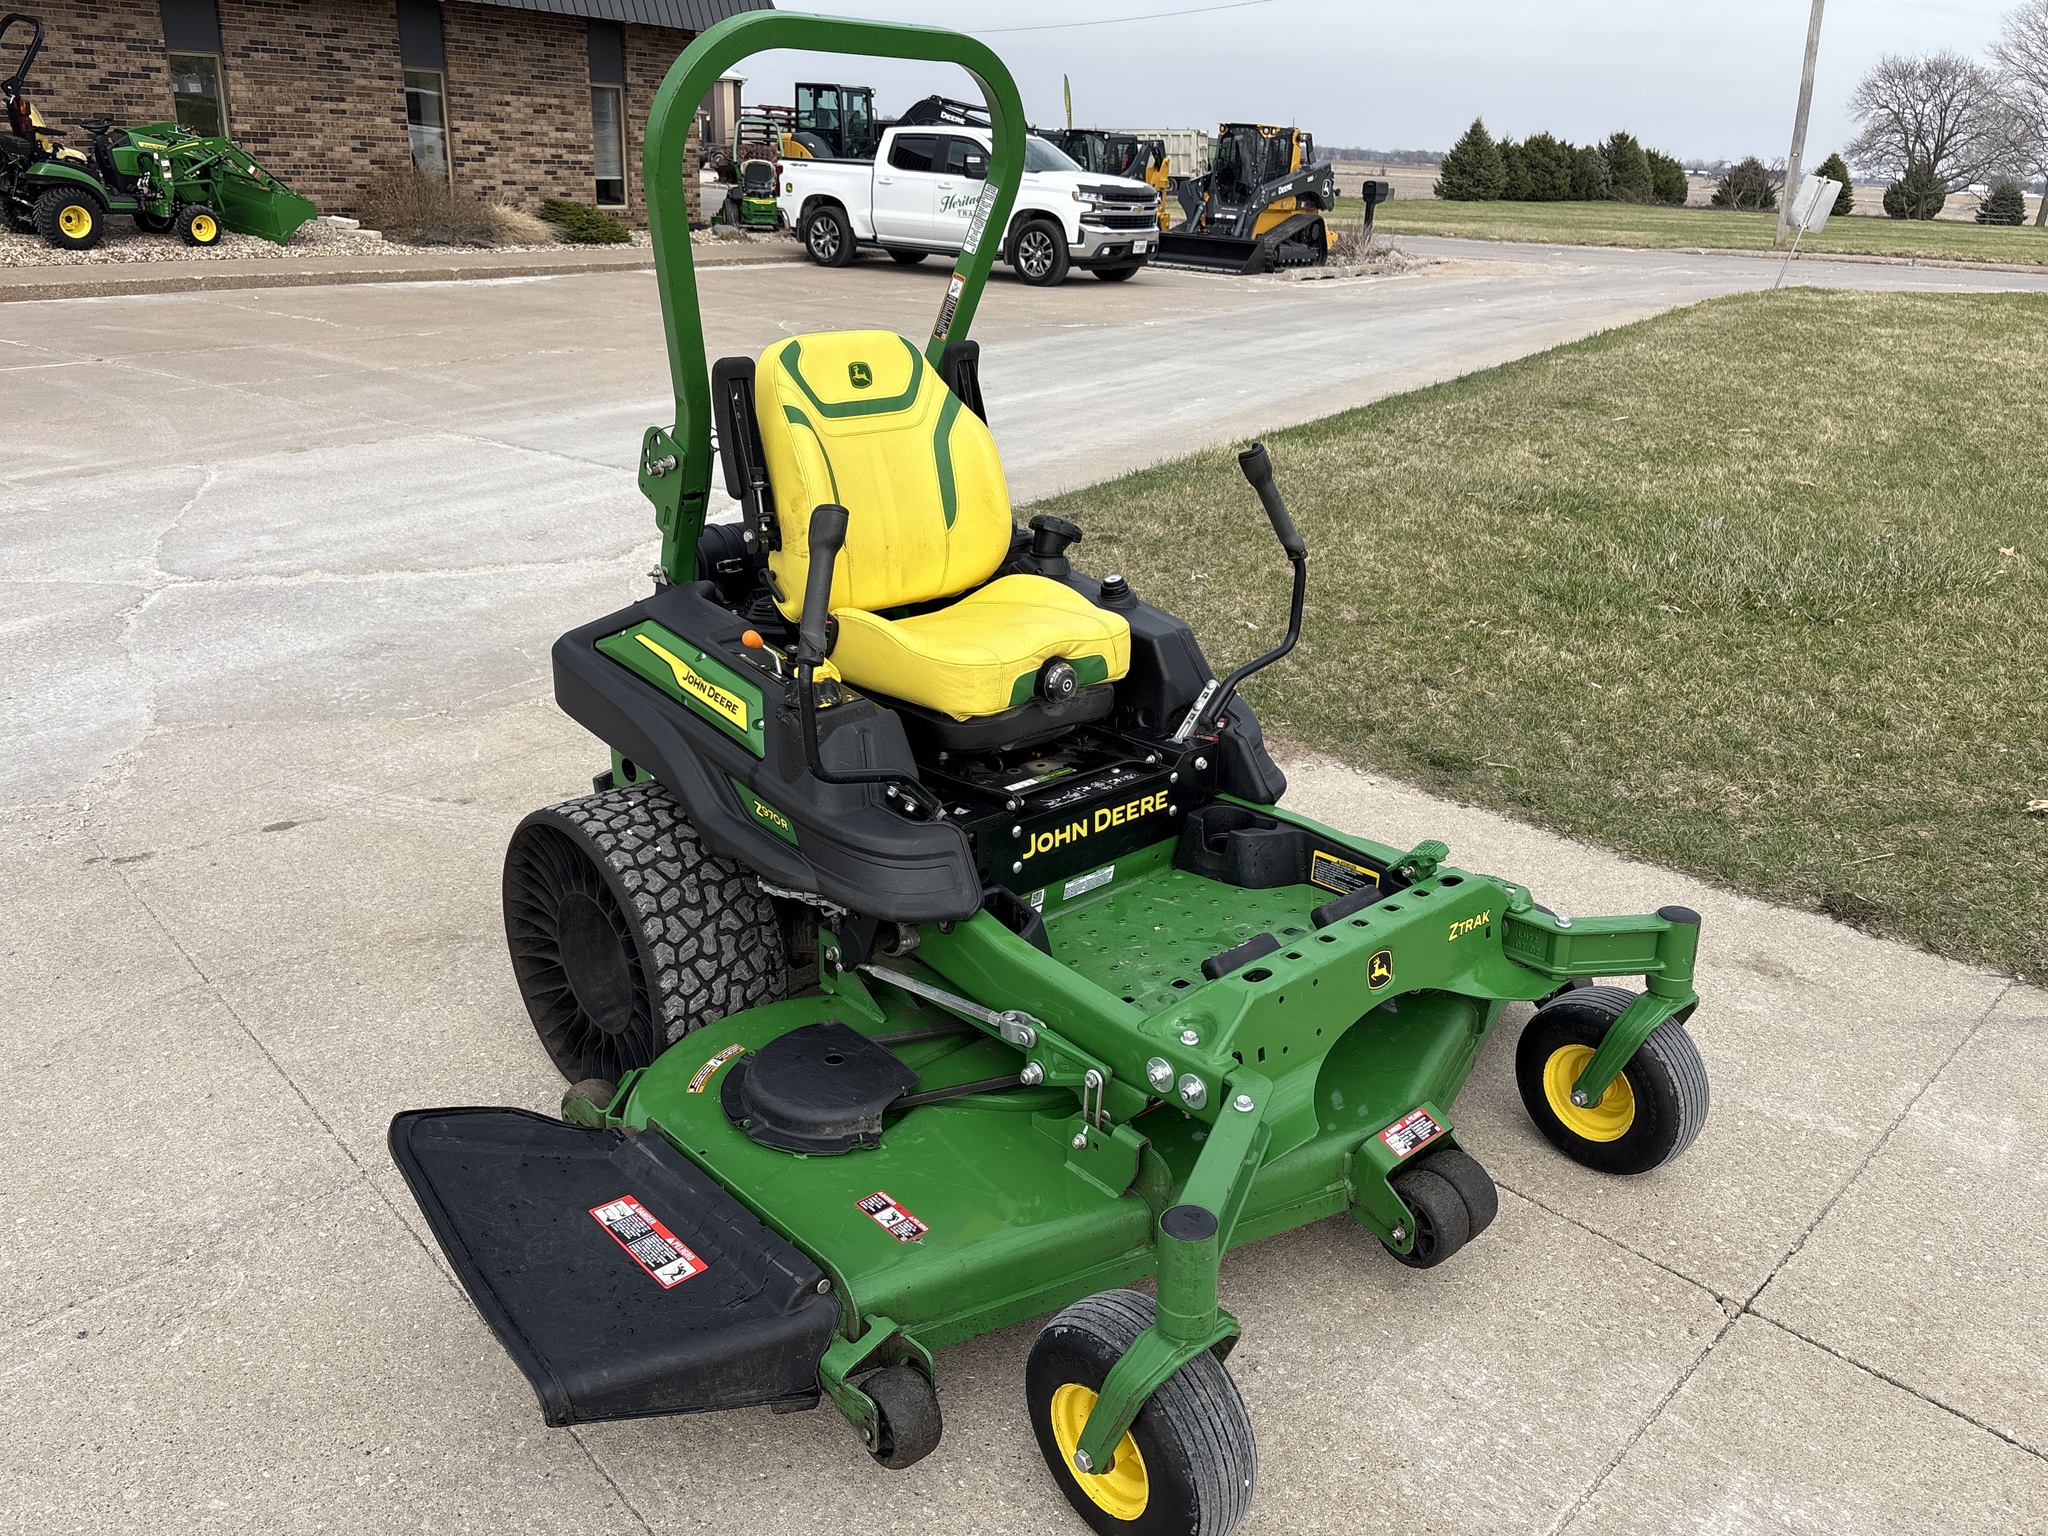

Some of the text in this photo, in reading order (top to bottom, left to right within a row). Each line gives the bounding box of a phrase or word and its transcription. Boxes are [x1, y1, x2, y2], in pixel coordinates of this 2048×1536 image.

[940, 110, 966, 125] DEERE
[940, 193, 981, 214] Heritag
[682, 670, 739, 716] JOHN DEERE
[753, 800, 789, 832] Z970R
[1022, 789, 1169, 860] JOHN DEERE
[1448, 908, 1491, 942] ZTRAK
[635, 1206, 657, 1225] DANGER
[672, 1241, 696, 1261] PELIGRO
